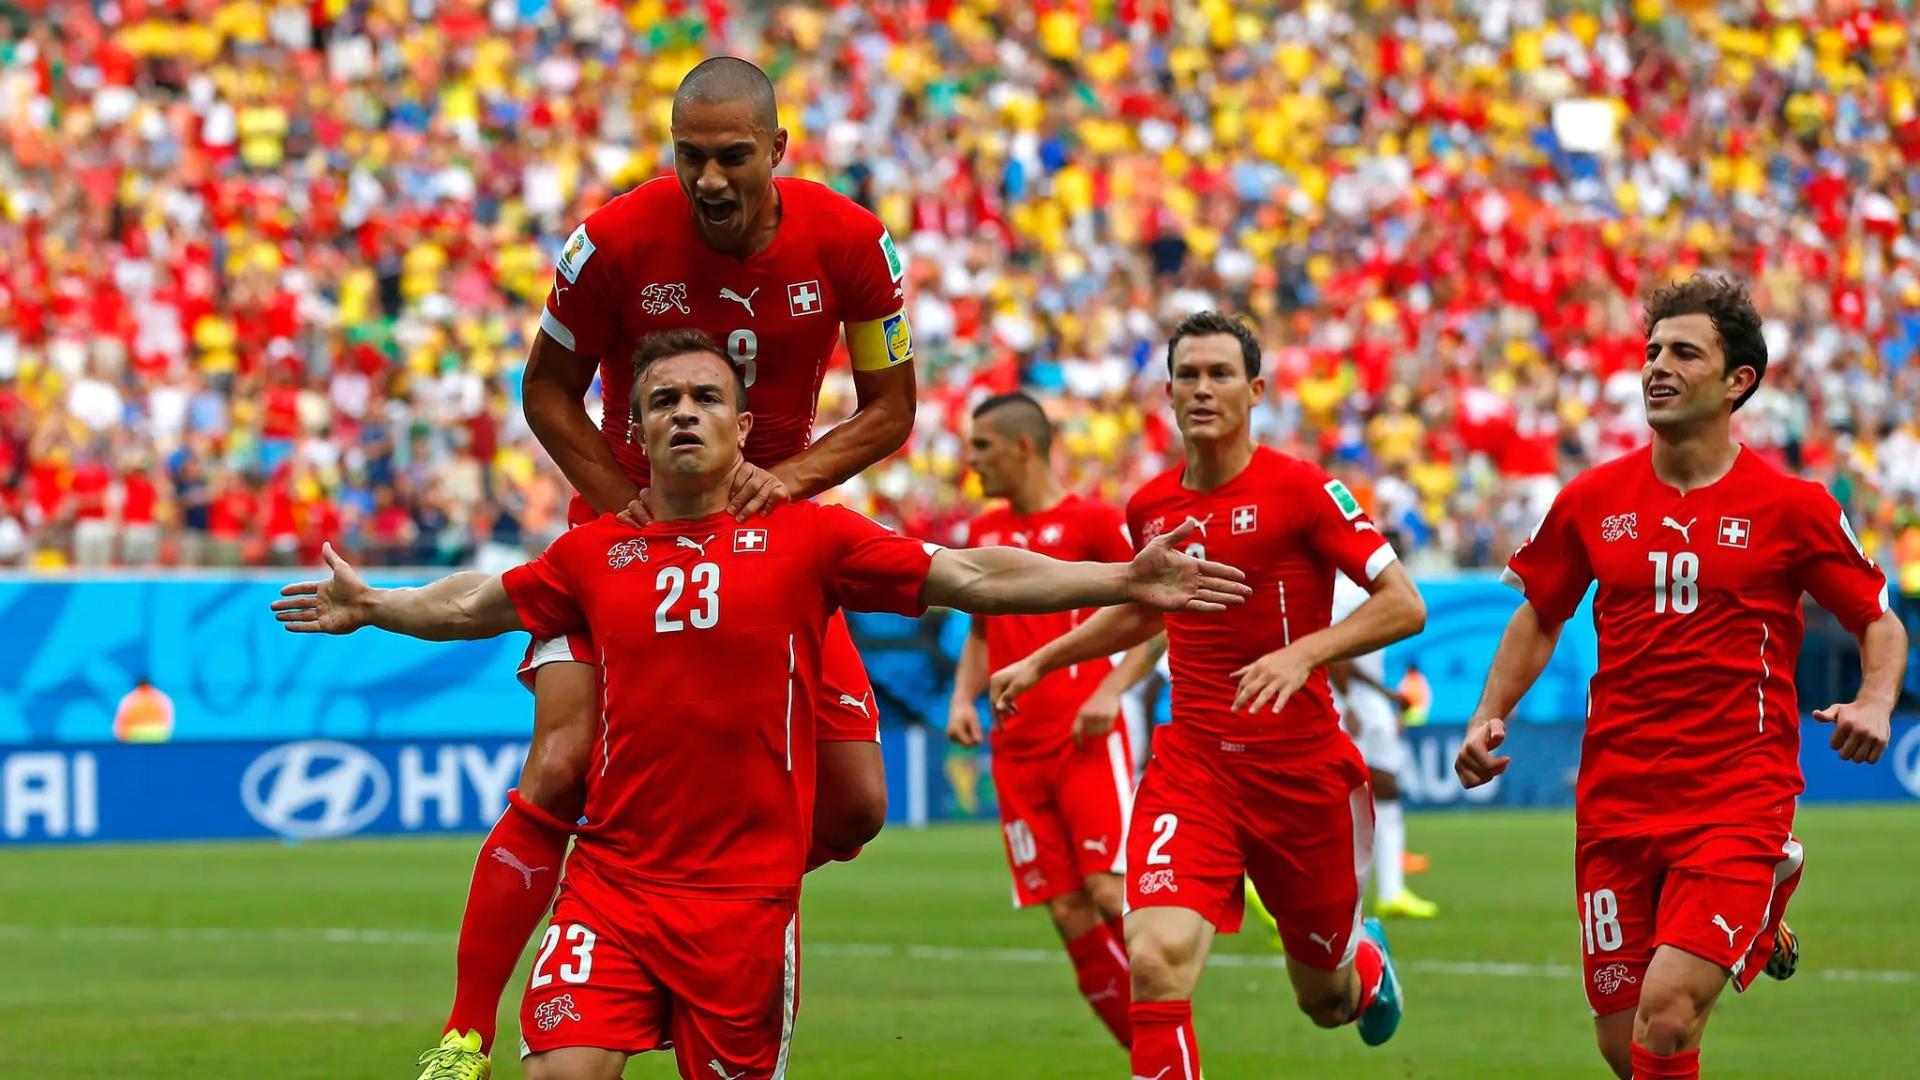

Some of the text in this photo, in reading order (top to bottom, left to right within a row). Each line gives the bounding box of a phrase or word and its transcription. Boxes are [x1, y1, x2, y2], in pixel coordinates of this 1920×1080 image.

[727, 328, 757, 388] 8
[655, 562, 721, 633] 23
[1648, 551, 1700, 614] 18
[399, 743, 529, 830] HY
[1005, 819, 1037, 867] 10
[1146, 813, 1178, 866] 2
[1583, 888, 1623, 955] 18
[531, 923, 596, 990] 23
